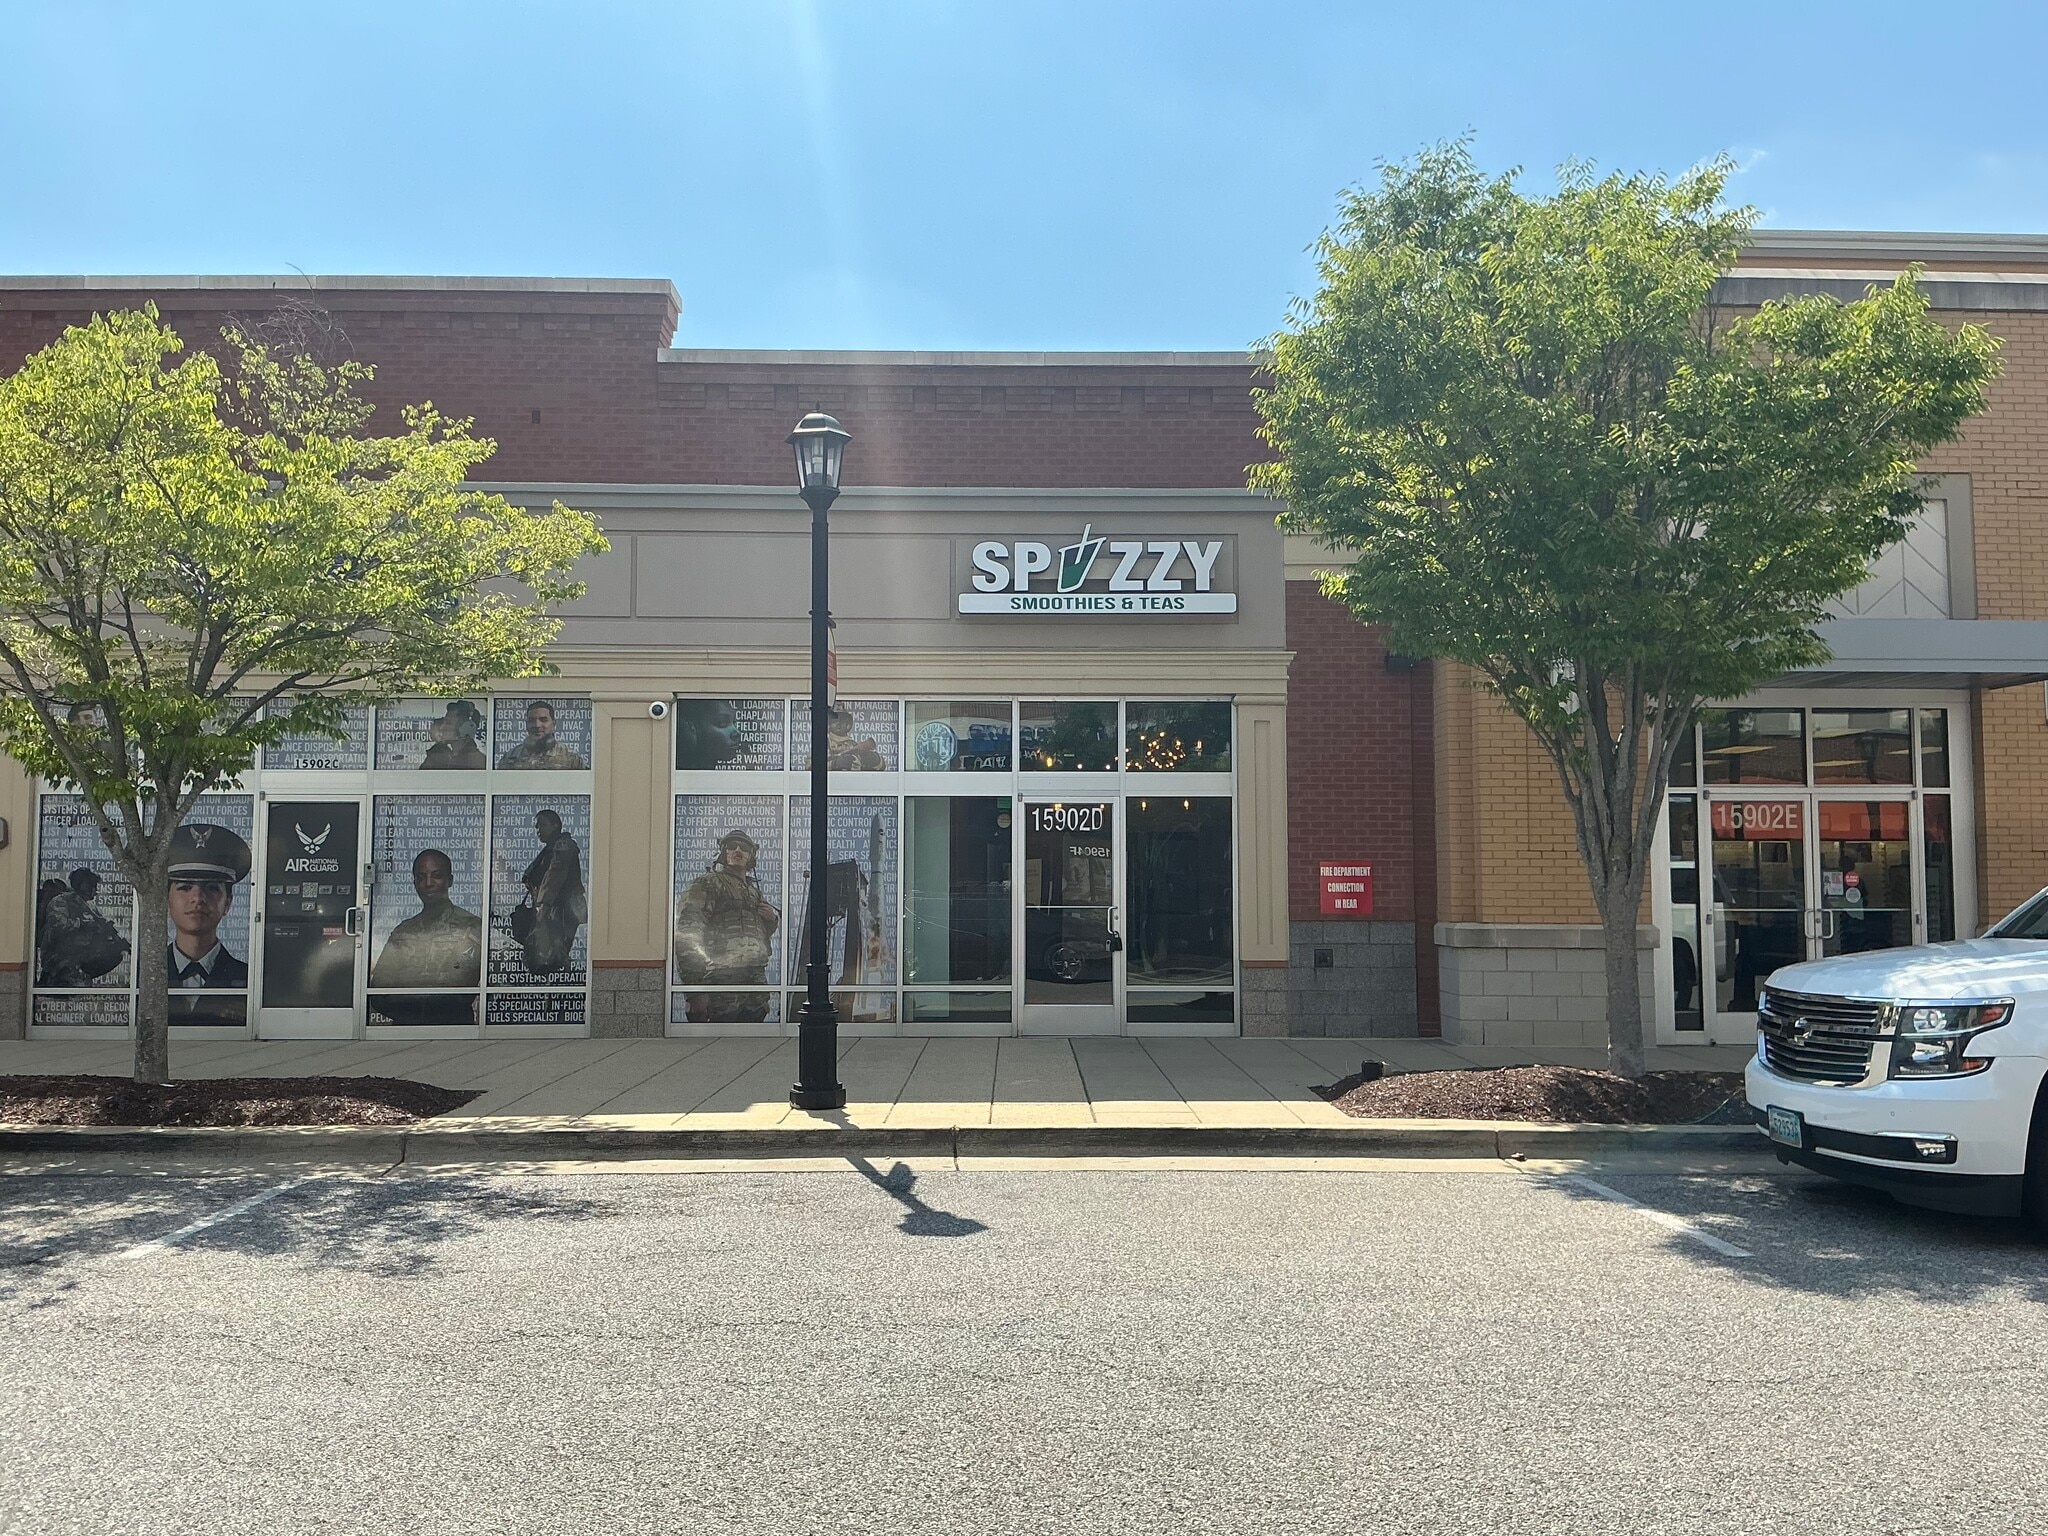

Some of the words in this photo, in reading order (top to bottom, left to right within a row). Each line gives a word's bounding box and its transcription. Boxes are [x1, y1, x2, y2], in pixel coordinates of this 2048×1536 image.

[1010, 597, 1115, 610] SMOOTHIES
[1121, 597, 1134, 610] &
[1138, 597, 1185, 610] TEAS
[854, 702, 892, 710] MANAGER
[735, 711, 775, 720] CHAPLAIN
[562, 721, 584, 730] HVAC
[736, 722, 758, 731] FIELD
[740, 732, 782, 742] TARGETING
[860, 733, 896, 742] CONTROL
[304, 742, 343, 751] DISPOSAL
[744, 755, 783, 764] WARFARE
[295, 760, 339, 769] 15902C
[726, 796, 755, 805] PUBLIC
[216, 806, 248, 815] FORCES
[379, 806, 400, 815] CIVIL
[402, 806, 442, 815] ENGINEER
[500, 805, 533, 815] SPECIAL
[688, 806, 725, 815] SYSTEMS
[726, 806, 776, 815] OPERATIONS
[862, 807, 893, 816] FORCES
[1031, 808, 1103, 831] 15902D
[1717, 804, 1798, 829] 15902E
[416, 817, 465, 826] EMERGENCY
[685, 817, 718, 826] OFFICER
[724, 817, 777, 827] LOADMASTER
[407, 828, 446, 837] ENGINEER
[374, 839, 406, 849] SPECIAL
[408, 839, 482, 849] RECONNAISSANCE
[506, 839, 535, 849] BATTLE
[284, 858, 310, 872] AIR
[309, 864, 340, 872] GUARD
[1320, 867, 1333, 876] FIRE
[1333, 867, 1371, 876] DEPARTMENT
[1327, 882, 1365, 892] CONNECTION
[1334, 899, 1342, 908] IN
[1342, 899, 1358, 908] REAR
[40, 1002, 66, 1011] CYBER
[68, 1002, 98, 1012] SURETY
[499, 1001, 546, 1011] SPECIALIST
[46, 1013, 84, 1022] ENGINEER
[512, 1012, 559, 1022] SPECIALIST
